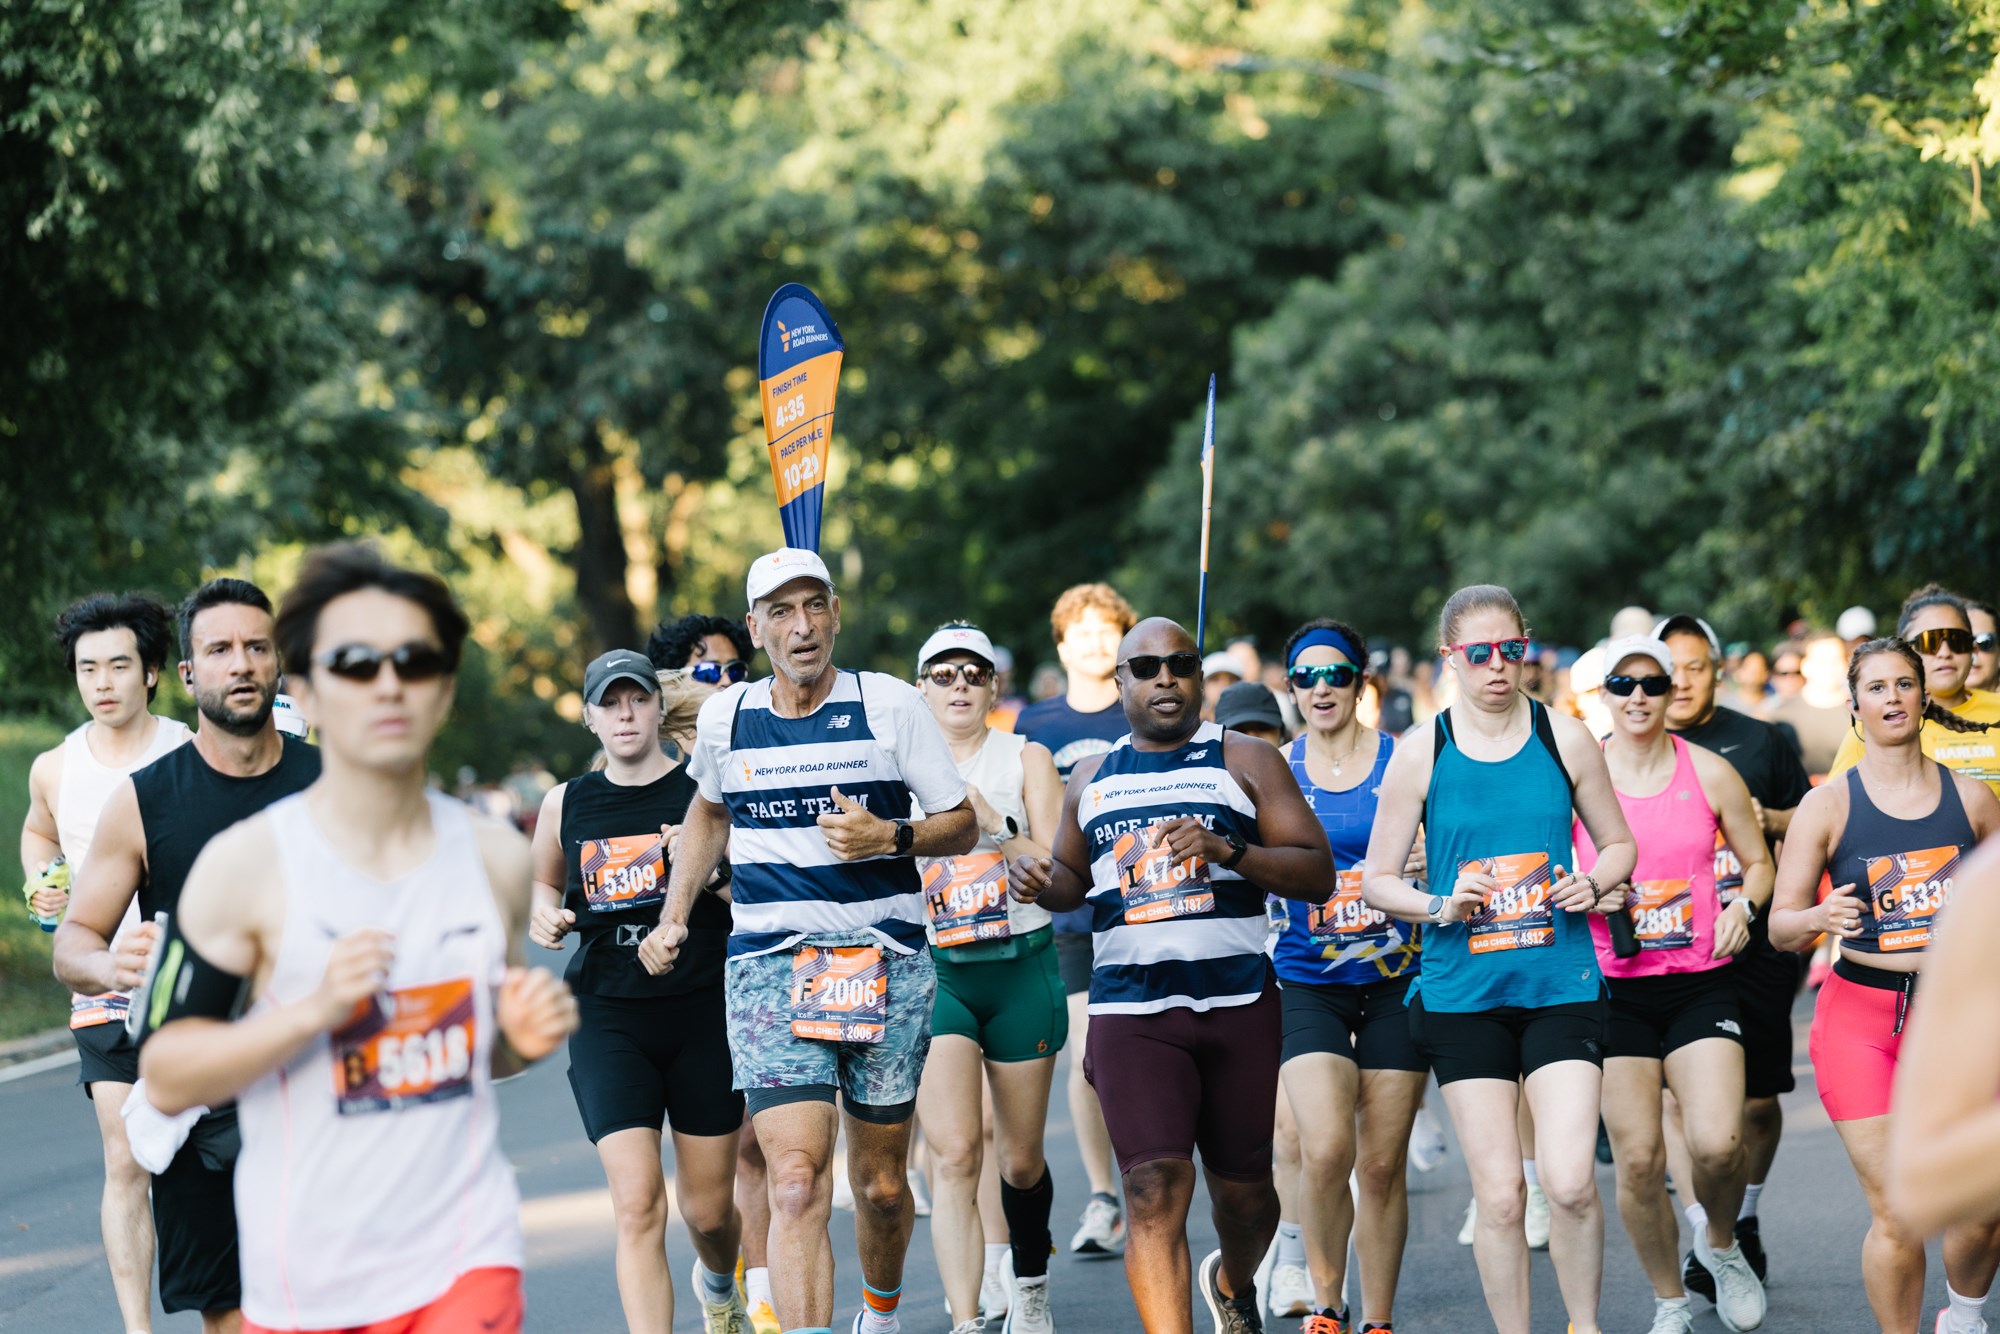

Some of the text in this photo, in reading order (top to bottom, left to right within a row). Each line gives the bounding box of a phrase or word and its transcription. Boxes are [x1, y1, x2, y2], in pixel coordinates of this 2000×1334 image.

[791, 325, 816, 338] NEW YORK
[792, 333, 828, 348] ROAD RUNNERS
[772, 372, 807, 398] FINISH TIME
[776, 394, 805, 427] 4:35
[780, 444, 796, 459] PACE
[796, 436, 807, 450] PER
[1934, 745, 1996, 760] HARLEM
[755, 760, 868, 776] NEW YORK ROAD RUNNERS
[1104, 782, 1218, 800] NEW YORK ROAD RUNNERS
[747, 800, 797, 818] PACE
[586, 864, 657, 896] H 5309
[1126, 864, 1138, 888] I
[931, 881, 999, 915] H 4979
[1489, 884, 1545, 916] 4812
[1879, 878, 1953, 913] G 5338
[1129, 898, 1201, 921] BAG CHECK 4787
[1316, 906, 1326, 927] I
[1633, 906, 1686, 935] 2881
[939, 924, 1000, 943] BAG CHECK 4979
[1472, 931, 1545, 949] BAG CHECK 4812
[1883, 937, 1902, 946] BAG
[1903, 933, 1932, 943] CHECK
[799, 978, 813, 1001] F
[821, 977, 878, 1007] 2006
[796, 1025, 873, 1040] BAG CHECK 2006
[378, 1024, 470, 1089] 5618
